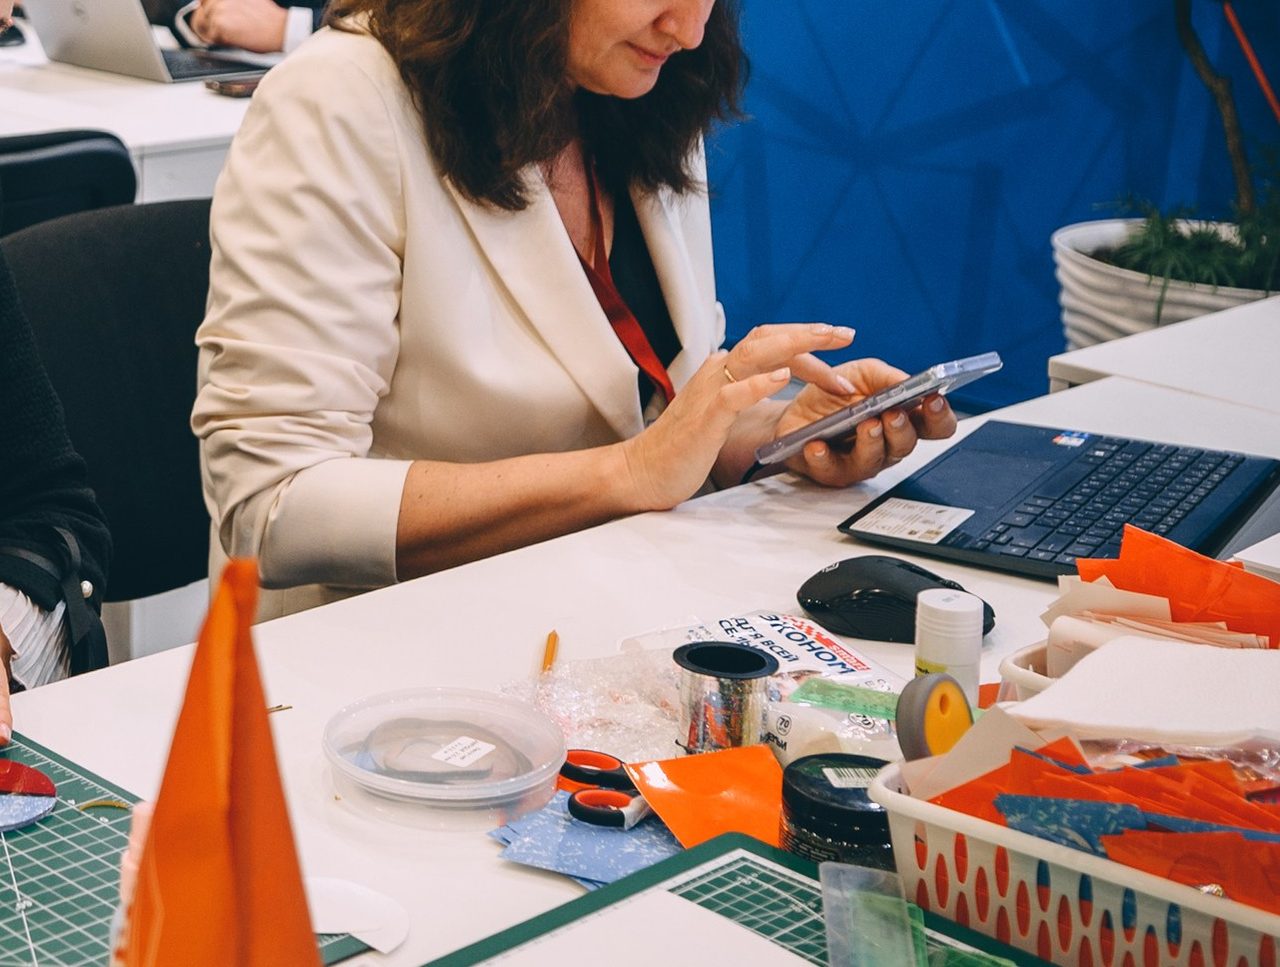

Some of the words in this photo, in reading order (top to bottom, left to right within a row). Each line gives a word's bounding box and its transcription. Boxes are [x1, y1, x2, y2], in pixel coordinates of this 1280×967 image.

[730, 617, 765, 640] ДЛЯ
[761, 640, 799, 663] ВСЕЙ
[759, 613, 837, 676] ЭКОНОМ
[778, 717, 790, 729] 70
